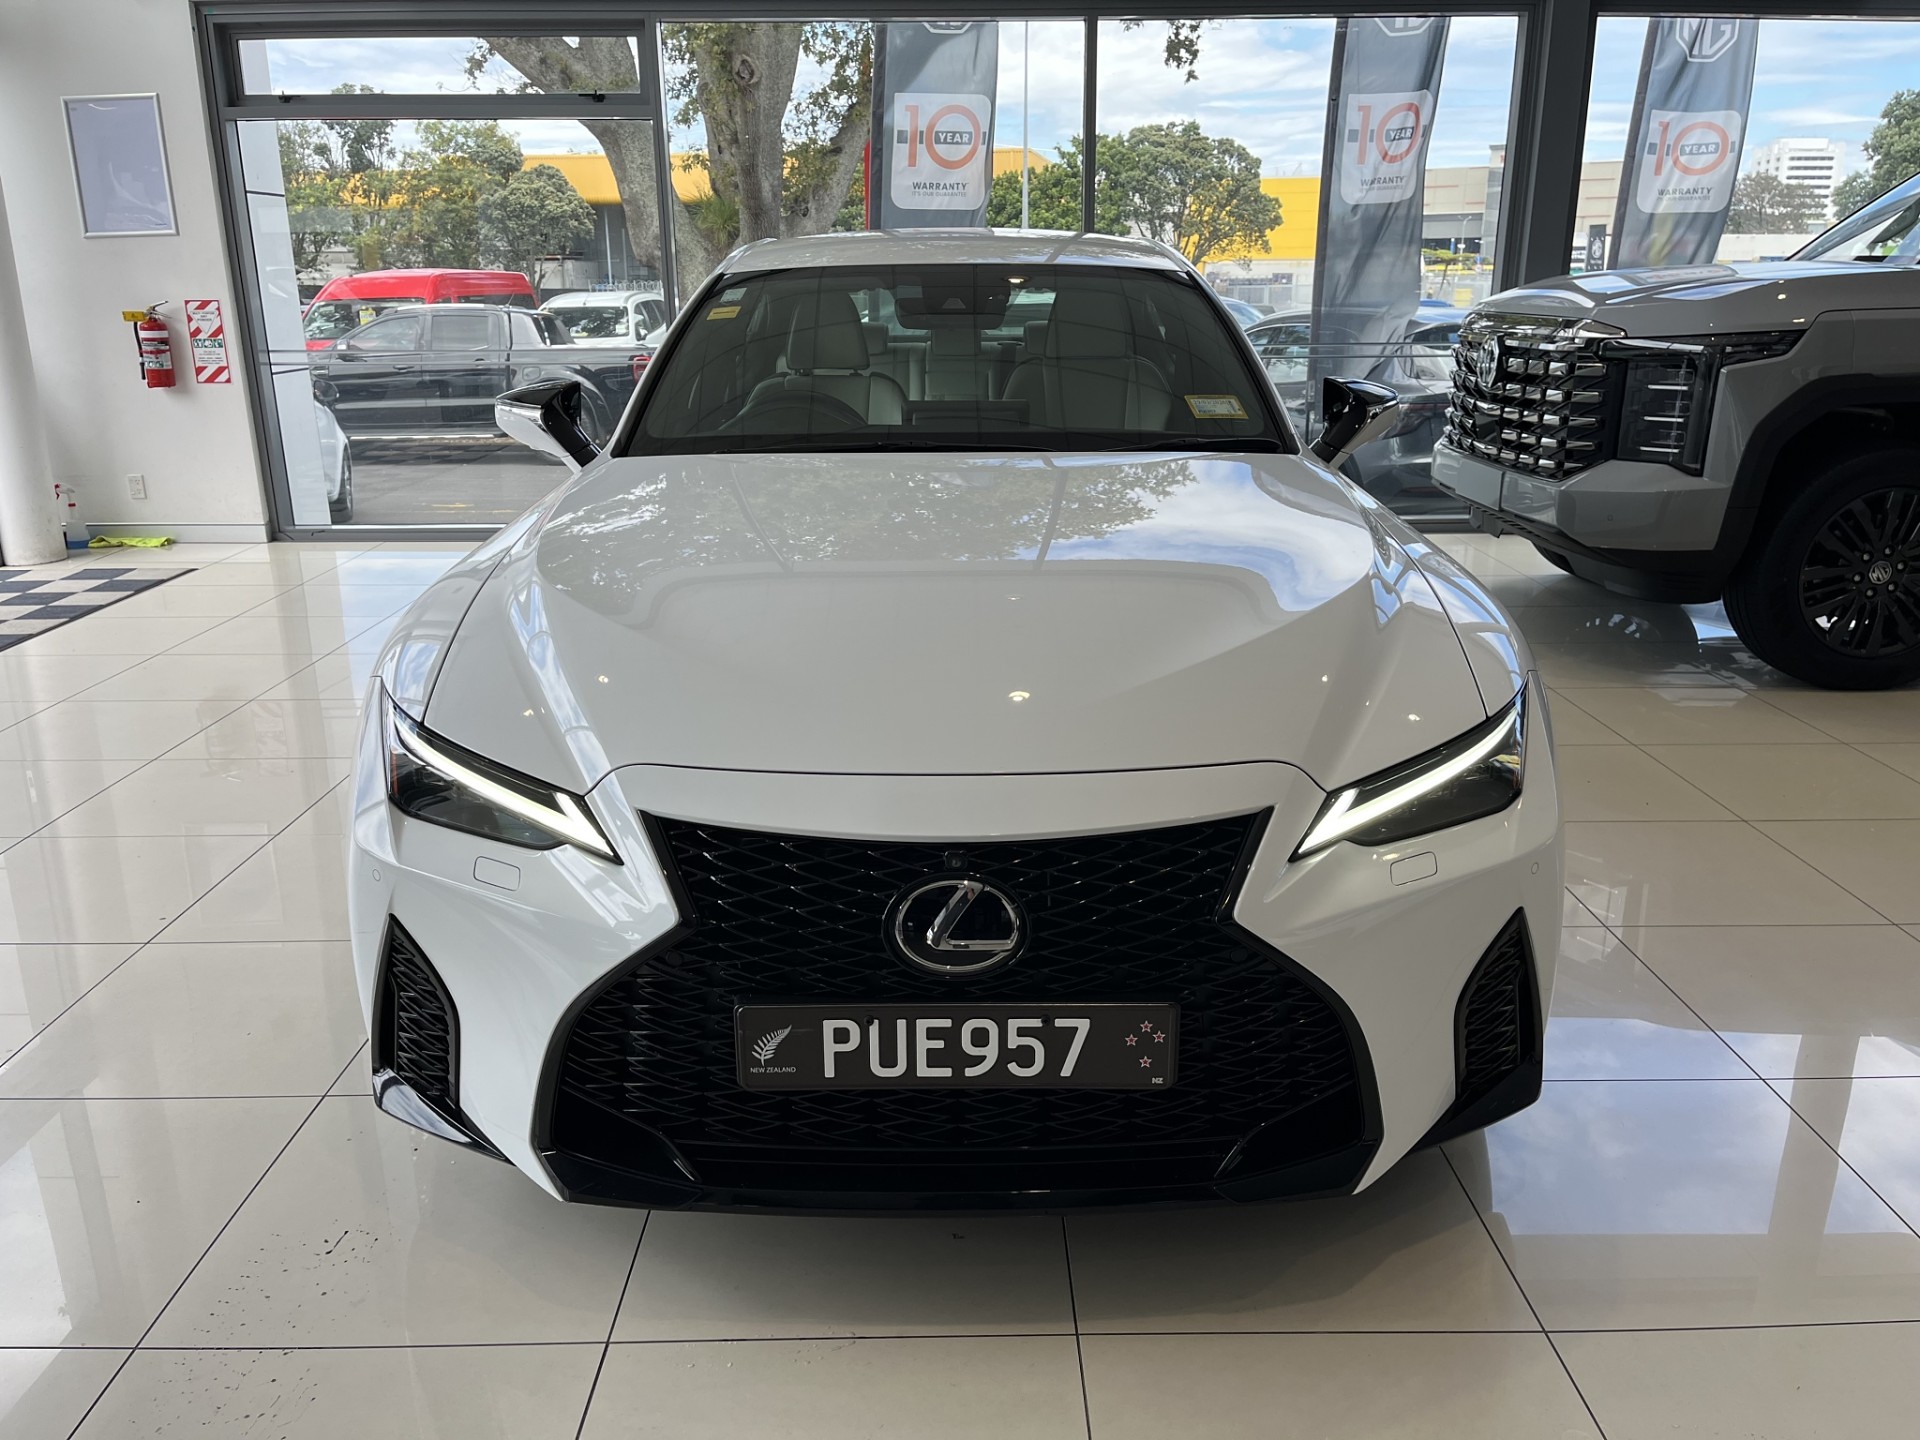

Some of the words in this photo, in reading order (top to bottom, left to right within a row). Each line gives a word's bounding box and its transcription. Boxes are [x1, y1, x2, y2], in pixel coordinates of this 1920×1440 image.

[905, 104, 981, 170] 10
[939, 132, 970, 143] YEAR
[1357, 102, 1421, 165] 10
[1389, 127, 1413, 141] YEAR
[1654, 120, 1730, 176] 10
[1684, 144, 1717, 154] YEAR
[912, 181, 967, 190] WARRANTY
[1657, 186, 1713, 196] WARRANTY
[1870, 564, 1891, 582] MG
[822, 1018, 1091, 1078] PUE957
